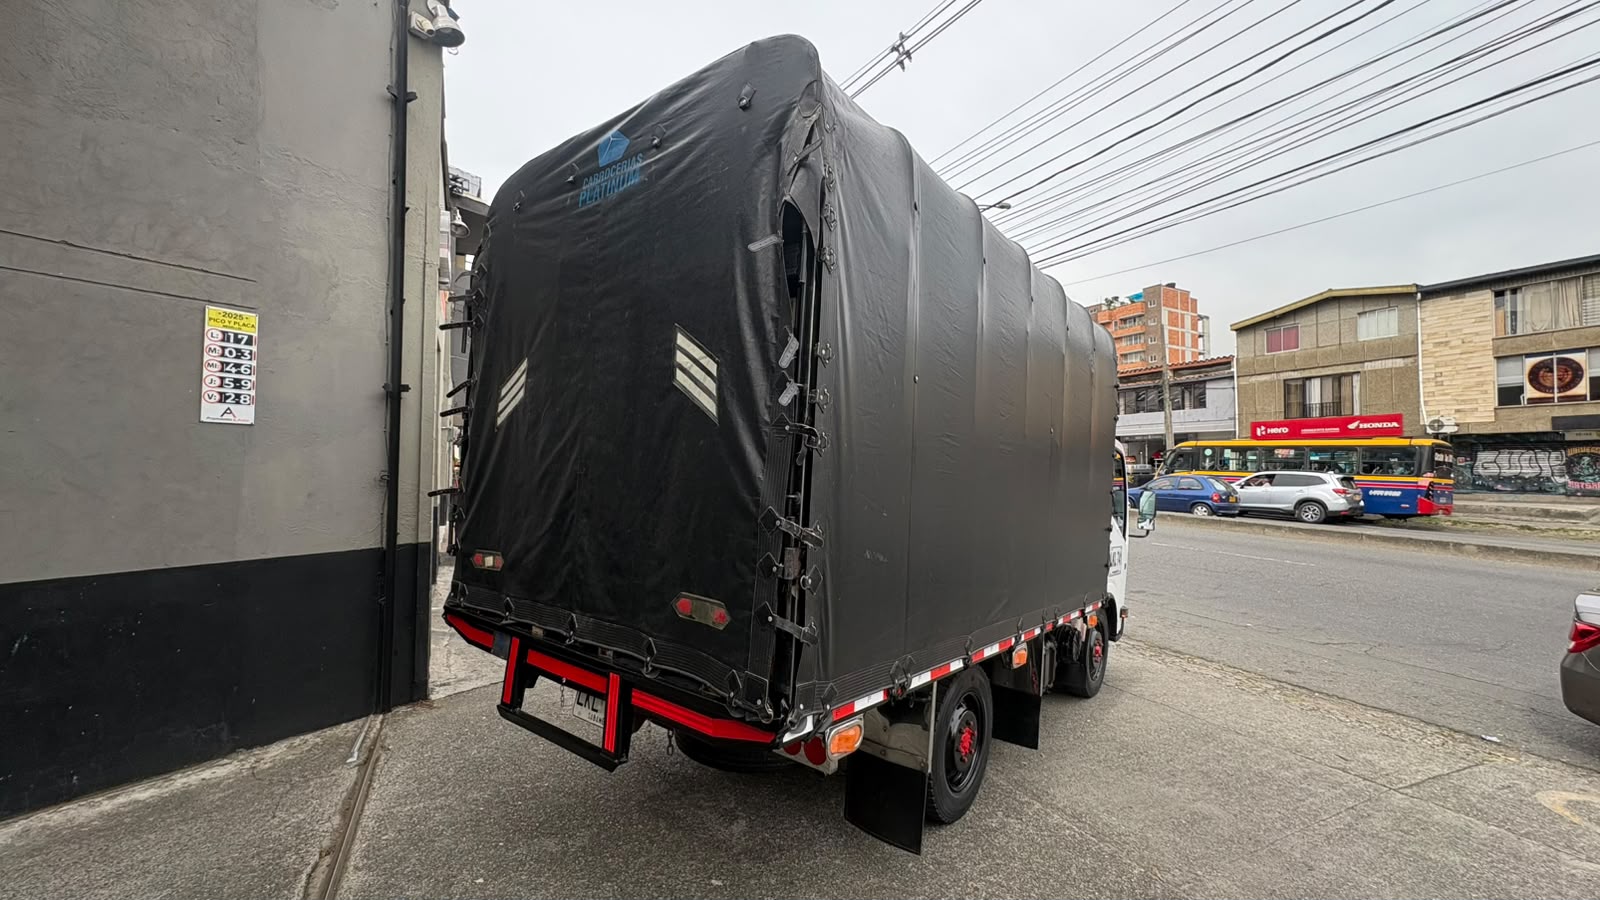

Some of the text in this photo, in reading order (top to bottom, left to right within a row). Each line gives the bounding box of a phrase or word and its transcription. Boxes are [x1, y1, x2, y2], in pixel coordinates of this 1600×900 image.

[578, 167, 641, 208] PLATINUM
[222, 311, 244, 321] 2025
[233, 321, 256, 329] PLACA
[1358, 421, 1400, 429] HONDA
